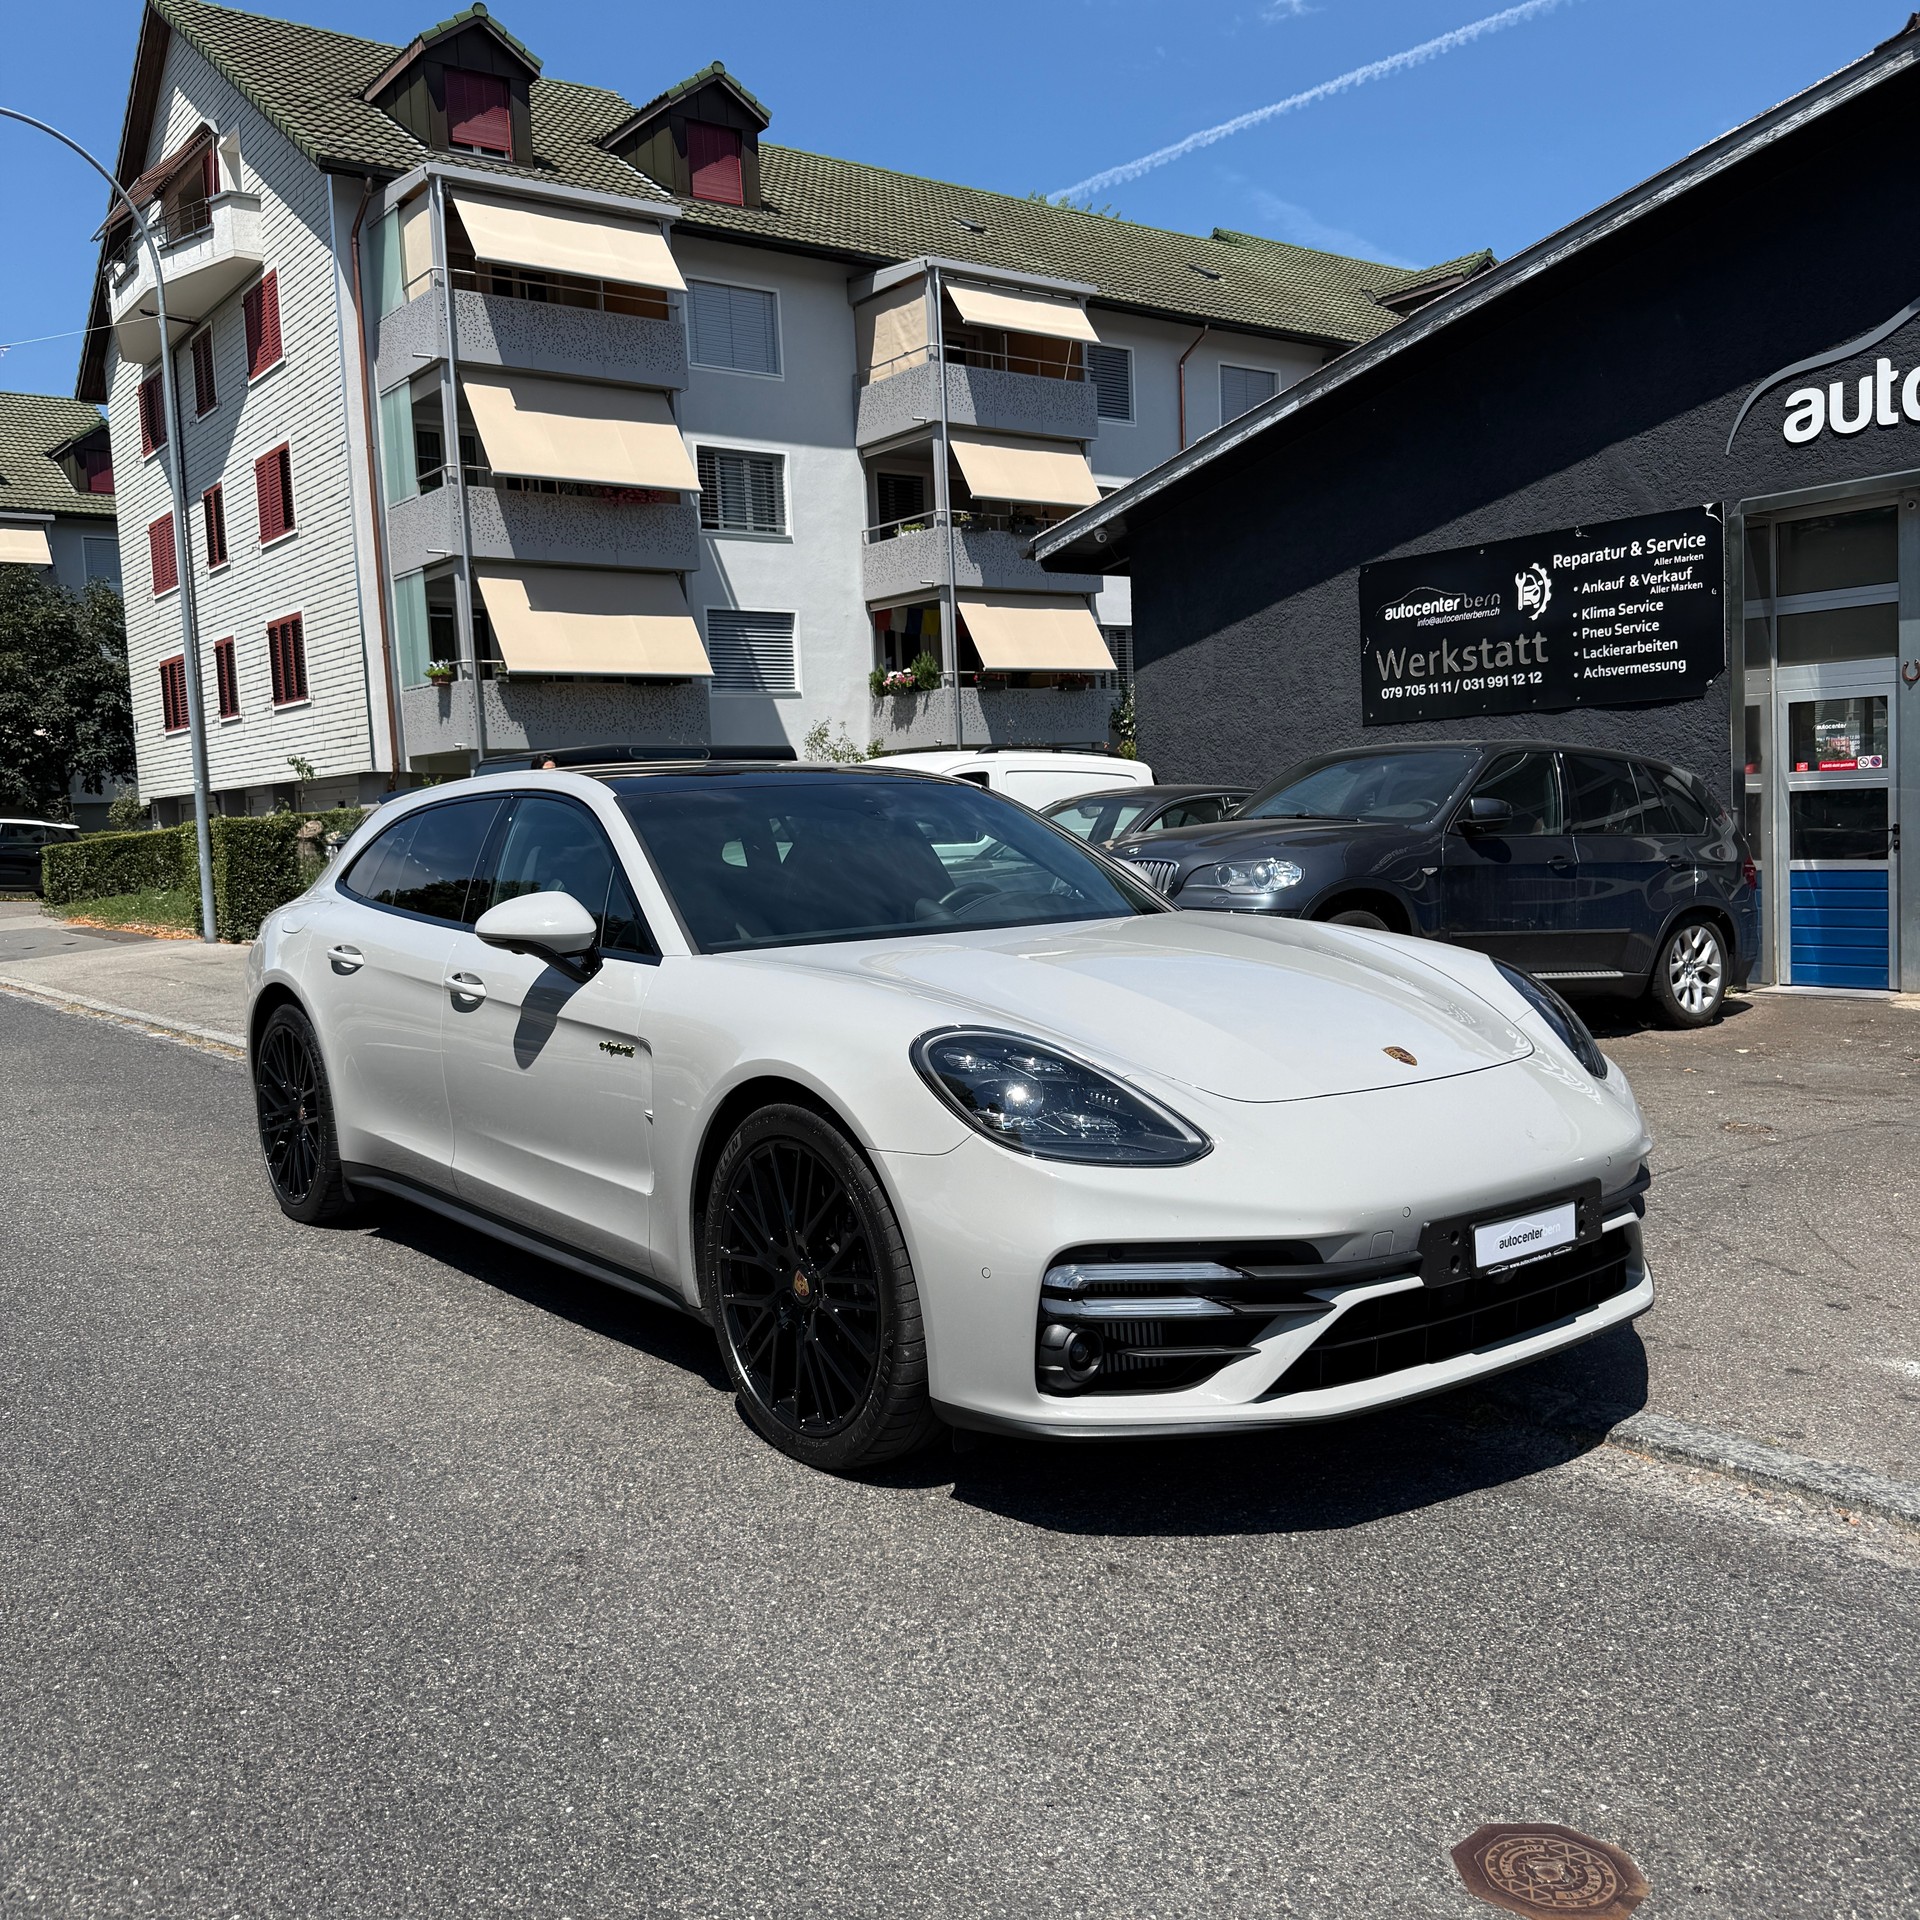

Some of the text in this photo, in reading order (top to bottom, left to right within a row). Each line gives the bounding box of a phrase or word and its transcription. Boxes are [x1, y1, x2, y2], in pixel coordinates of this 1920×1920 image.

[1553, 533, 1706, 570] Reparatur & Service
[1654, 553, 1704, 566] Aller Marken
[1581, 567, 1693, 594] Ankauf & Verkauf
[1650, 582, 1703, 594] Aller Marken
[1385, 593, 1500, 620] autocenter bern
[1582, 600, 1664, 620] Klima Service
[1417, 607, 1500, 627] info@autocenterbern.ch
[1582, 620, 1660, 639] Pneu Service
[1376, 631, 1549, 681] Werkstatt
[1583, 639, 1678, 659] Lackierarbeiten
[1584, 659, 1686, 678] Achsvermessung
[1381, 671, 1542, 700] 079 705 11 11 / 031 991 12 12
[1499, 1228, 1543, 1249] autocenter
